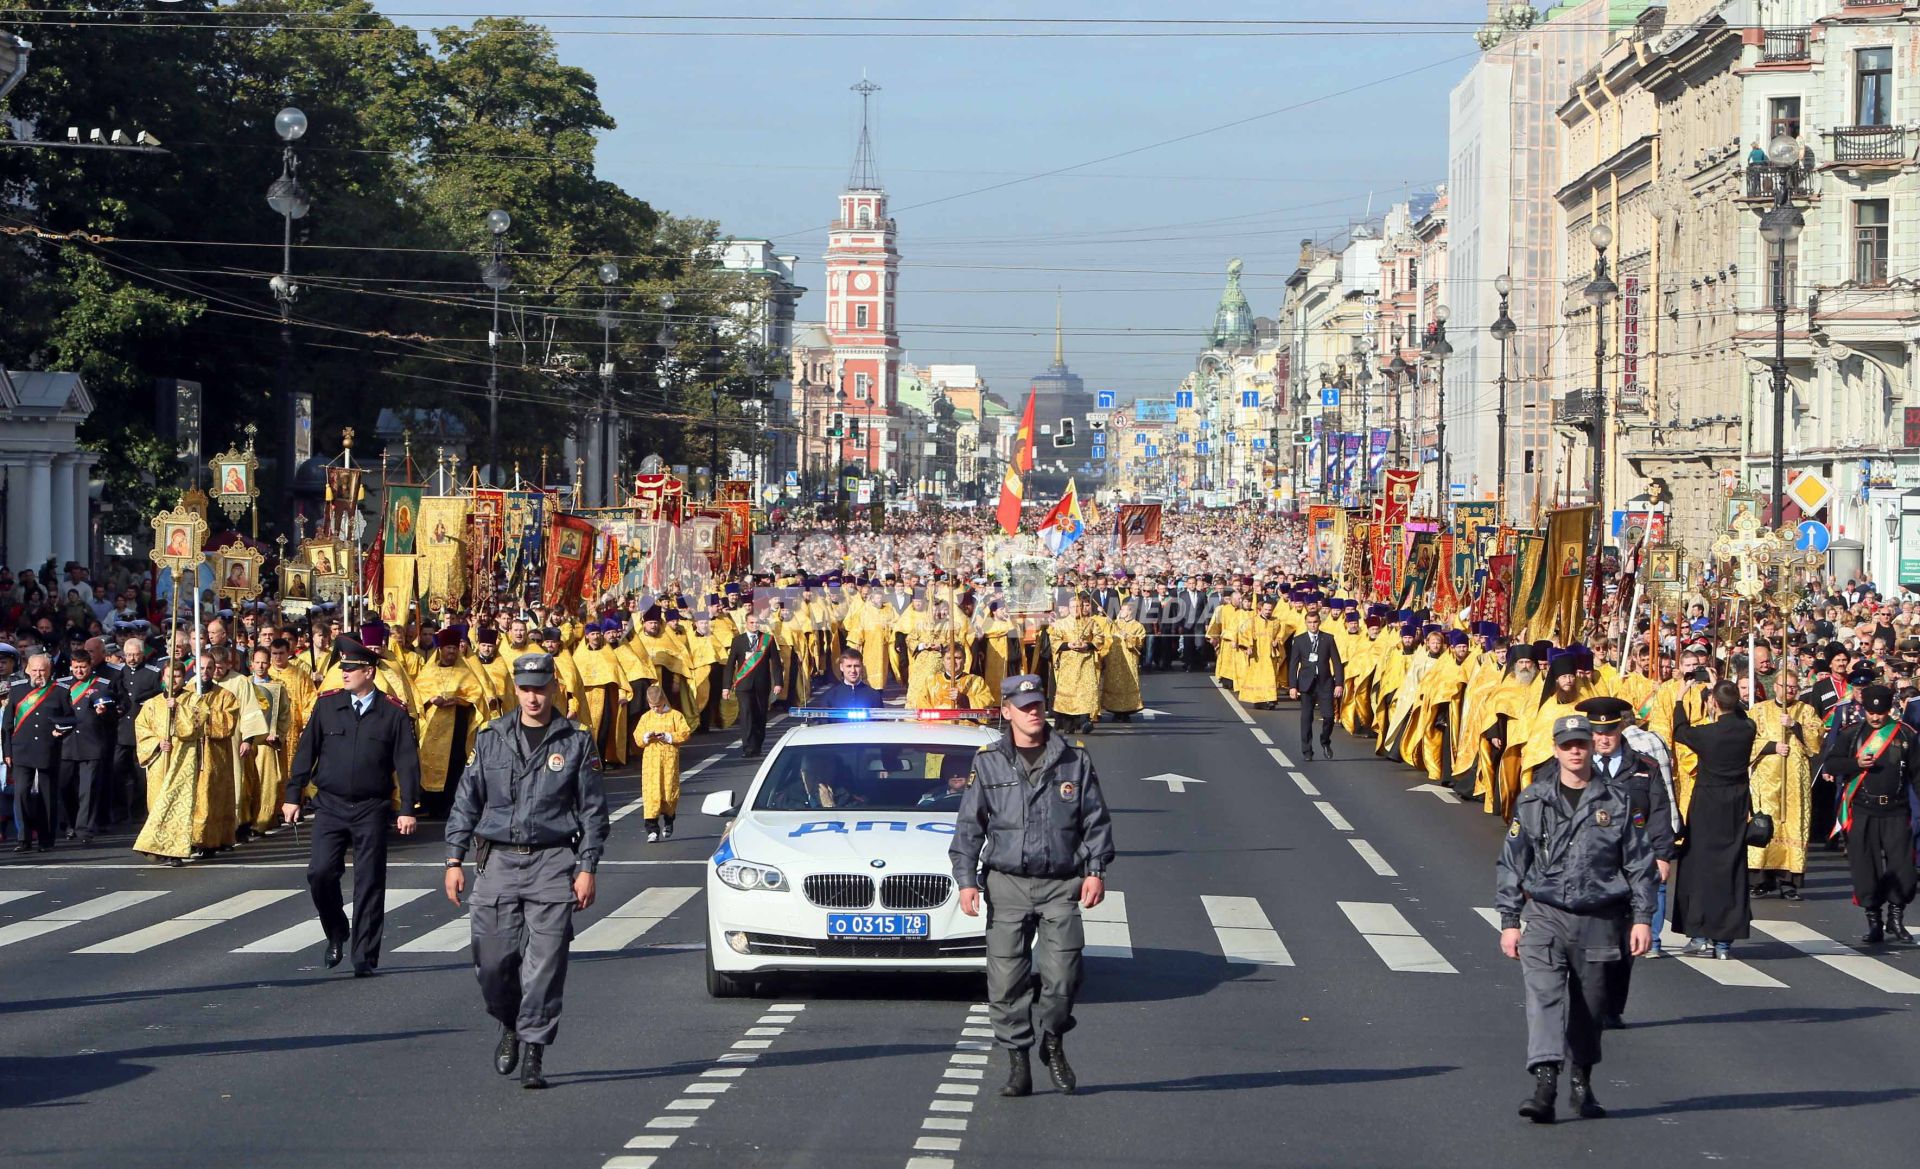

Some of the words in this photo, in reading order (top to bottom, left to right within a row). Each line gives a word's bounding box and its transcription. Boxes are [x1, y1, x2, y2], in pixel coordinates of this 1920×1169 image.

[788, 821, 958, 838] ДПС
[852, 916, 895, 933] 0315
[905, 916, 921, 928] 78
